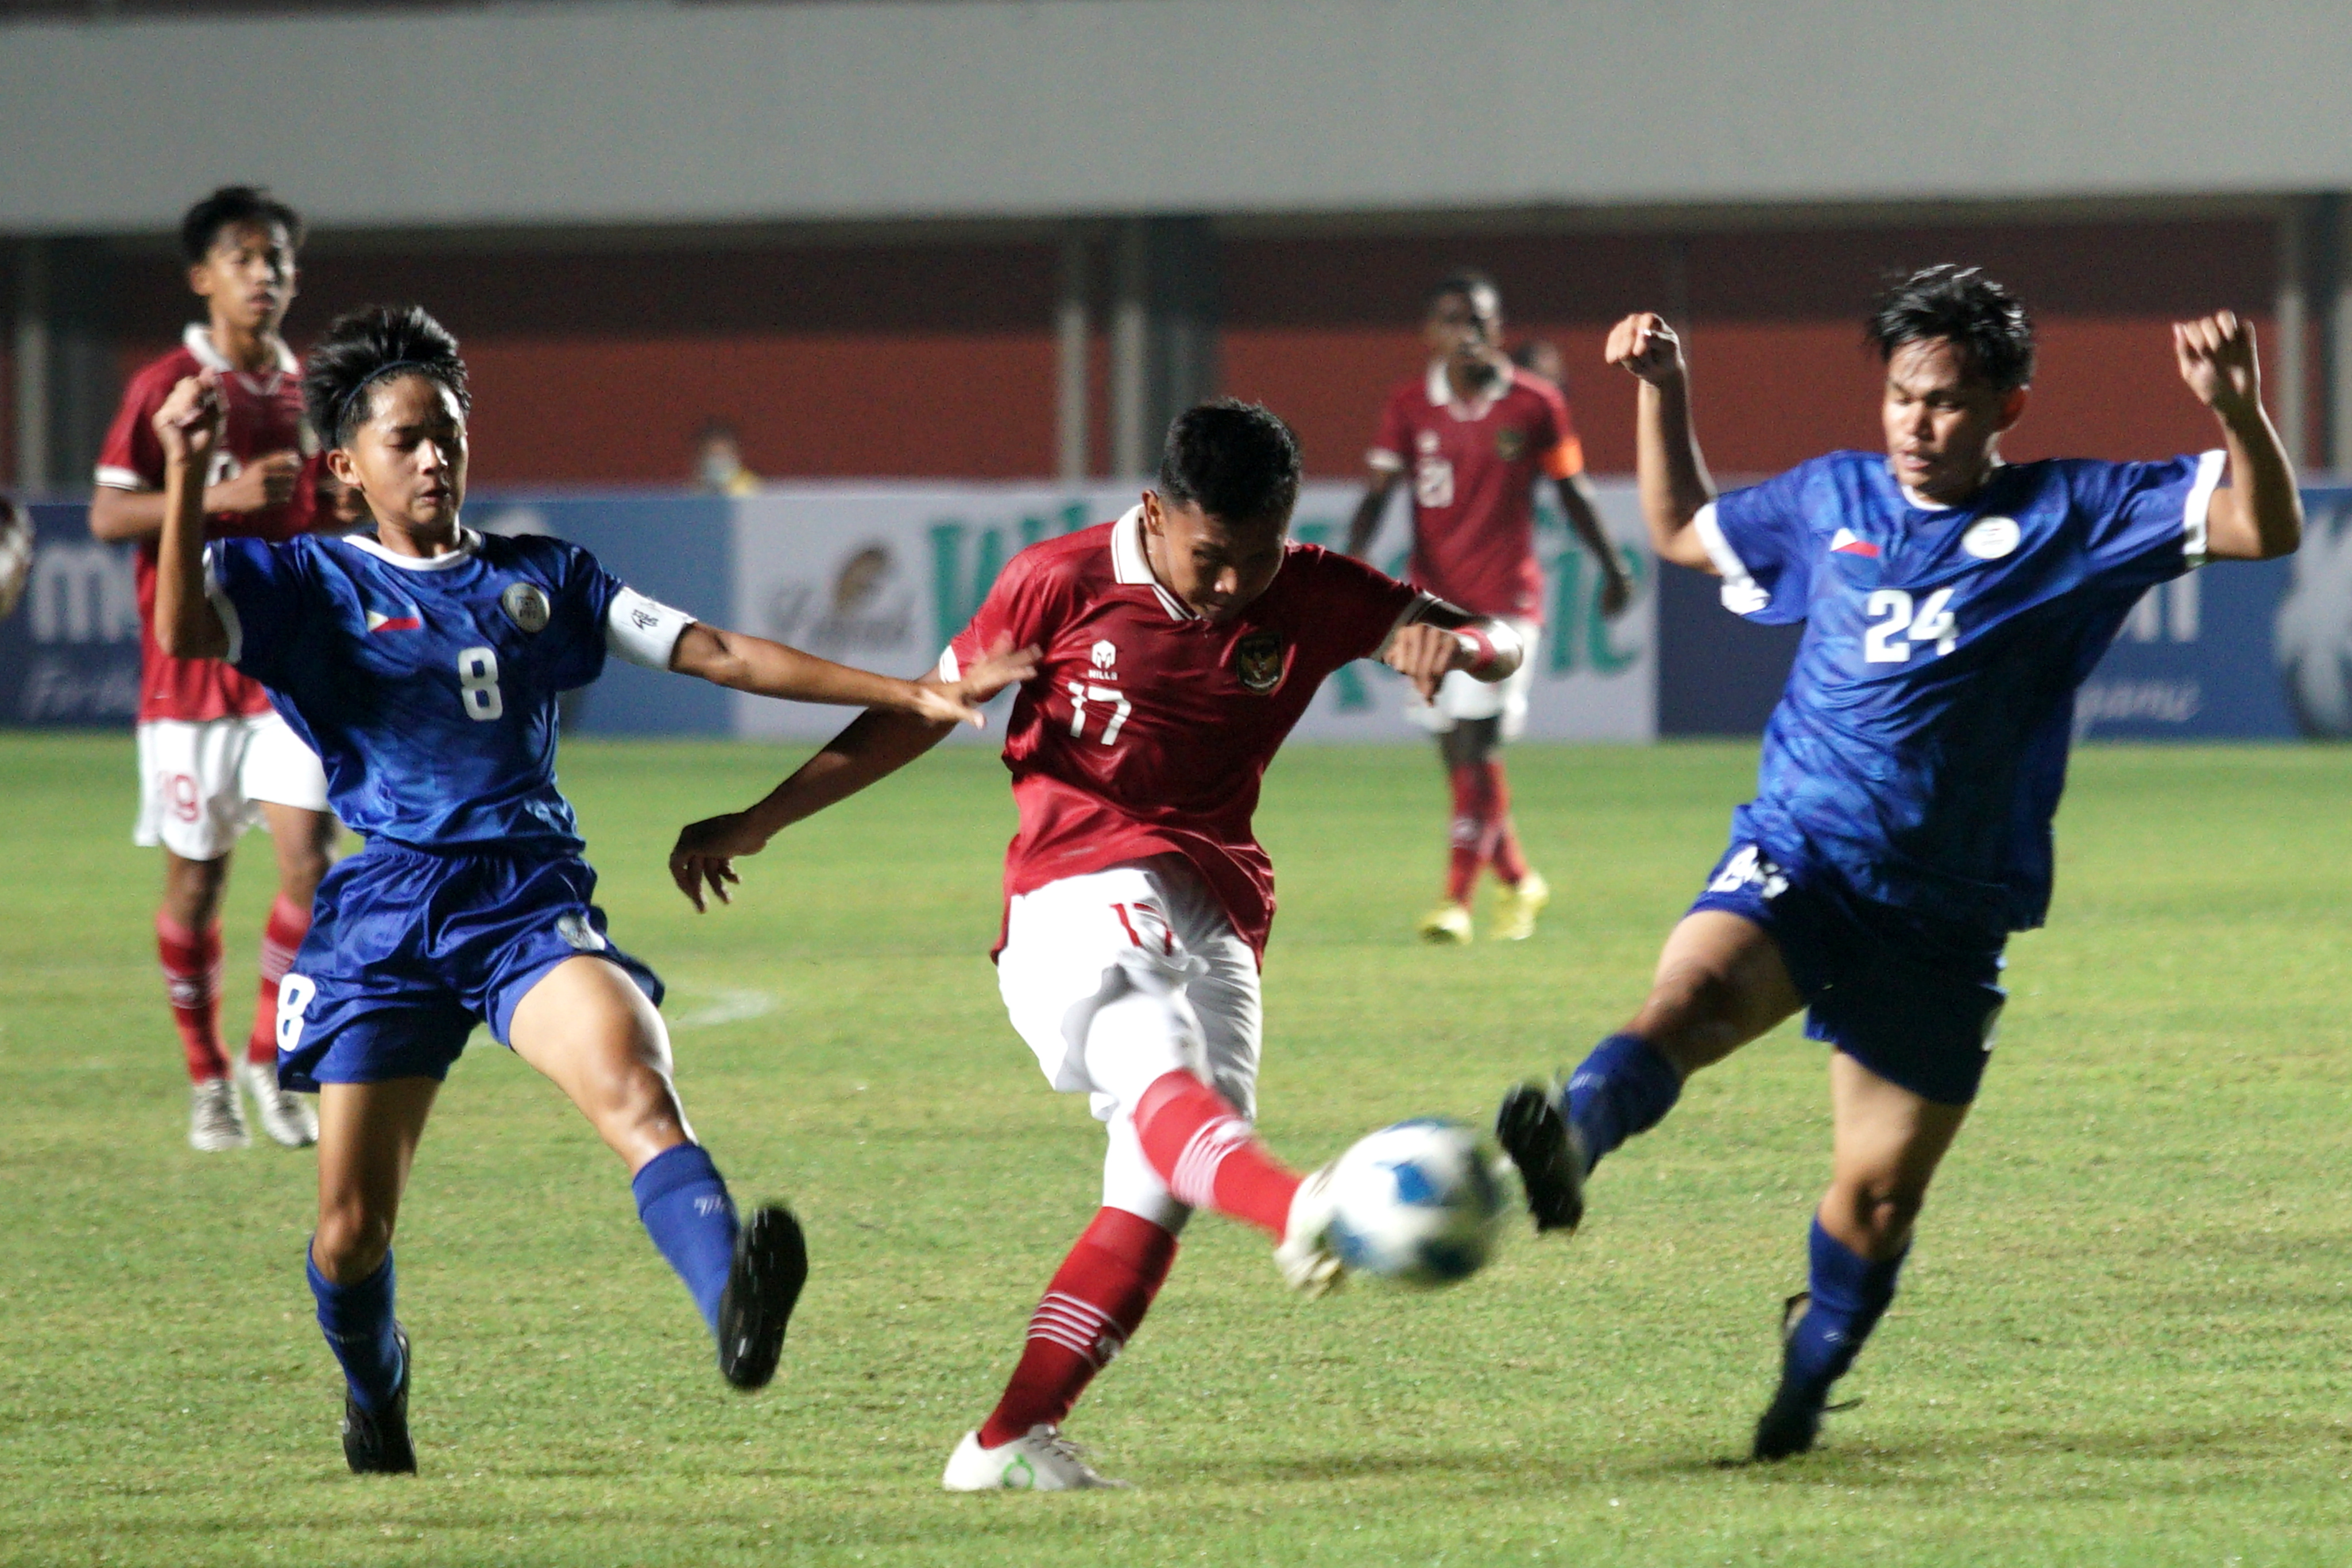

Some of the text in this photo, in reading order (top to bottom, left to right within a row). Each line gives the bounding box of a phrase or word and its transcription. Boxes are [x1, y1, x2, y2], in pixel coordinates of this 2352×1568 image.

[1864, 588, 1960, 663] 24
[458, 646, 503, 721] 8
[1088, 669, 1118, 682] MILLS
[1067, 682, 1132, 746] 17
[1108, 902, 1174, 957] 17
[276, 973, 316, 1052] 8
